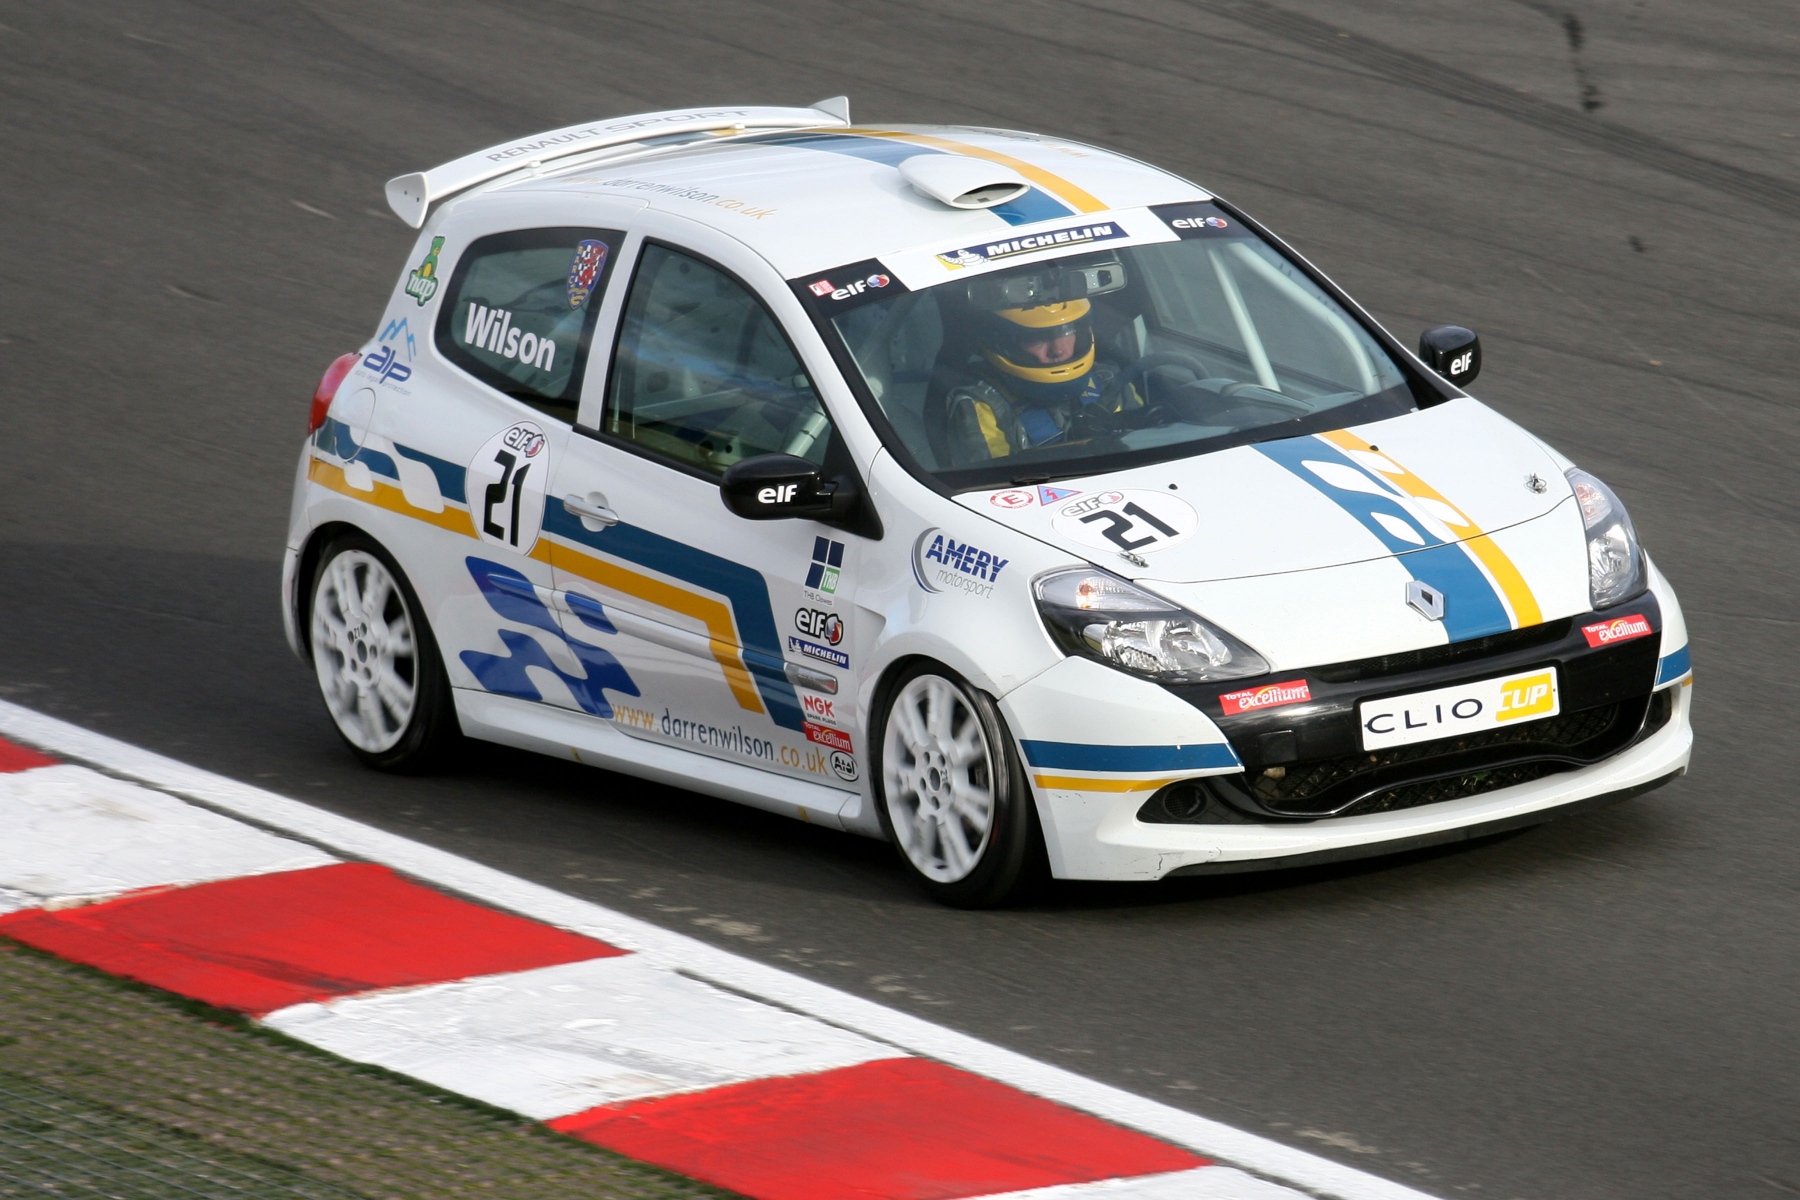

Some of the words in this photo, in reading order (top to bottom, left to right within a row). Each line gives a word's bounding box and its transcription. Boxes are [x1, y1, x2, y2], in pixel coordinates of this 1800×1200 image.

[486, 128, 600, 162] RENAULT
[605, 110, 749, 133] SPORT
[1172, 217, 1205, 228] elf
[986, 225, 1113, 256] MICHELIN
[831, 280, 866, 300] elf
[465, 302, 556, 372] Wilson
[1450, 351, 1473, 375] elf
[503, 427, 535, 452] elf
[483, 449, 531, 547] 21
[758, 484, 797, 504] elf
[1061, 495, 1106, 518] elf
[1079, 501, 1180, 551] 21
[925, 534, 1009, 583] AMERY
[822, 570, 839, 590] THB
[936, 568, 994, 600] motorsport
[796, 608, 827, 638] elf
[1585, 624, 1608, 633] TOTAL
[1599, 621, 1648, 641] excellium
[803, 643, 848, 665] MICHELIN
[804, 695, 835, 718] NGK
[1224, 691, 1254, 701] TOTAL
[1239, 686, 1309, 709] excellium
[1365, 698, 1483, 734] CLIO
[1500, 683, 1549, 712] CUP
[803, 721, 827, 732] TOTAL
[611, 703, 829, 776] www.darrenwilson.co.uk
[813, 730, 852, 751] excellium
